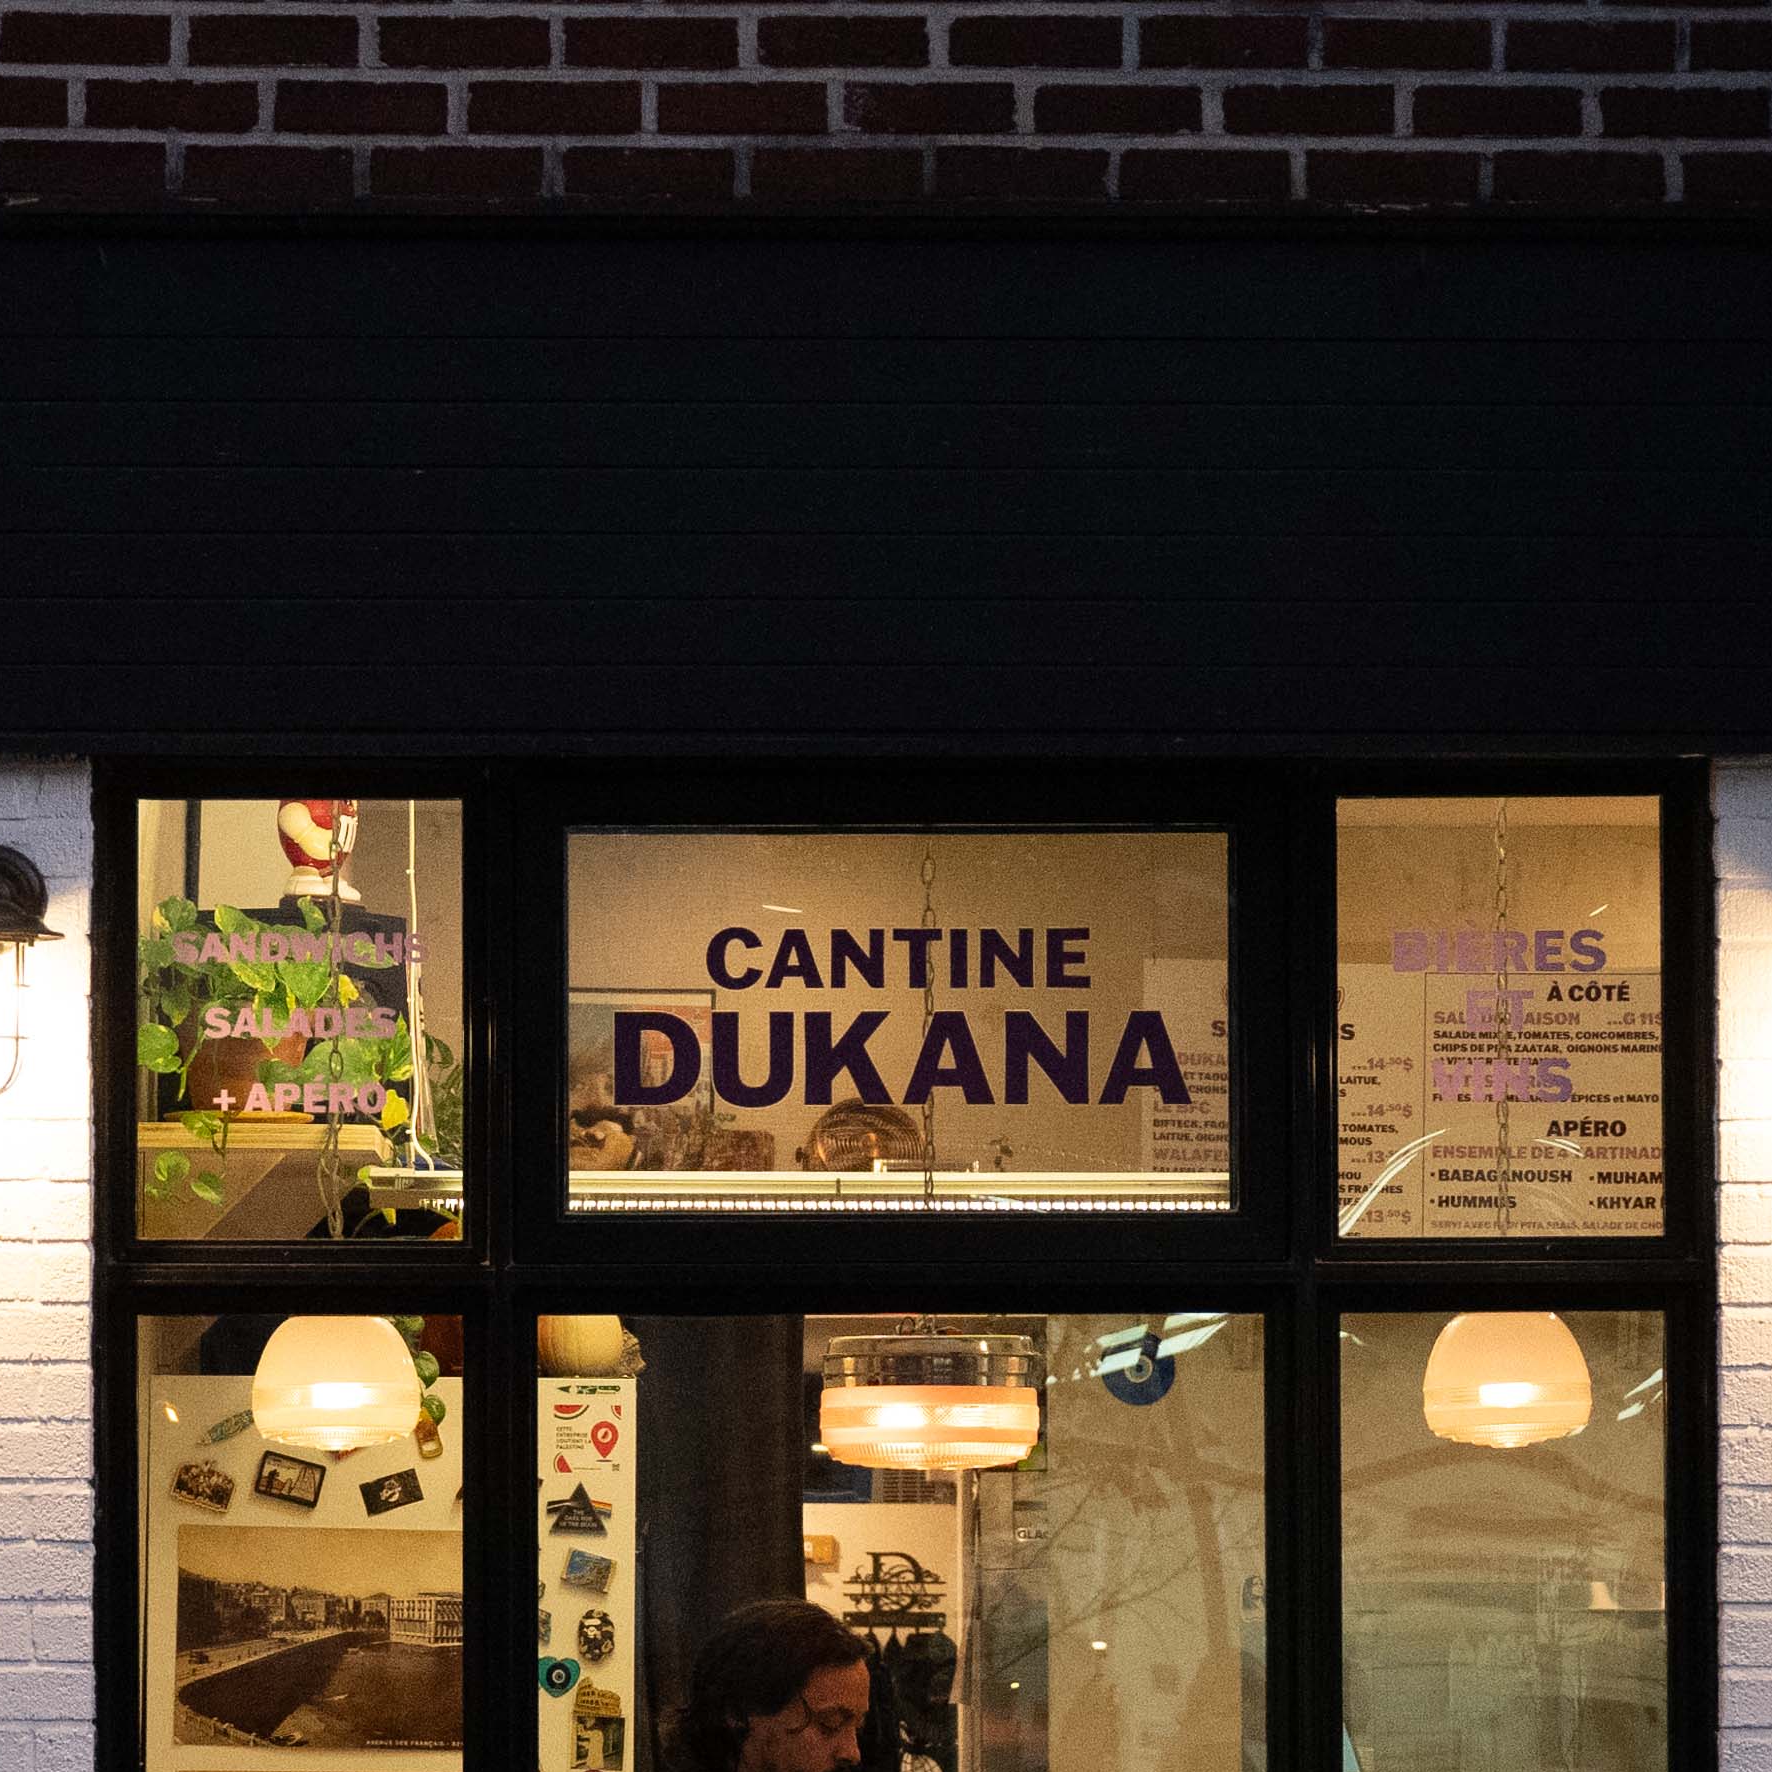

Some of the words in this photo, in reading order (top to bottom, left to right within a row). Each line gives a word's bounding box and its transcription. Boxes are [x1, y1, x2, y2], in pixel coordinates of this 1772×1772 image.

[1393, 920, 1607, 972] BIÈRES
[706, 927, 1091, 989] CANTINE
[1547, 981, 1563, 1002] À
[1568, 980, 1630, 1002] CÔTÉ
[205, 1006, 397, 1039] SALADES
[1466, 990, 1534, 1033] ET
[1509, 1011, 1581, 1025] AISON
[1518, 1031, 1575, 1041] TOMATES,
[1575, 1031, 1659, 1042] CONCOMBRES,
[613, 1011, 1193, 1106] DUKANA
[1433, 1043, 1468, 1053] CHIPS
[1470, 1044, 1485, 1052] DE
[1566, 1044, 1619, 1053] OIGNONS
[1434, 1059, 1574, 1103] VINS
[245, 1074, 388, 1113] APÉRO
[1626, 1094, 1659, 1103] MAYO
[1547, 1116, 1627, 1137] APÉRO
[1432, 1145, 1527, 1159] ENSEMLE
[1531, 1146, 1554, 1160] DE
[1576, 1147, 1662, 1160] ARTINAD
[1597, 1197, 1657, 1210] KHYAR
